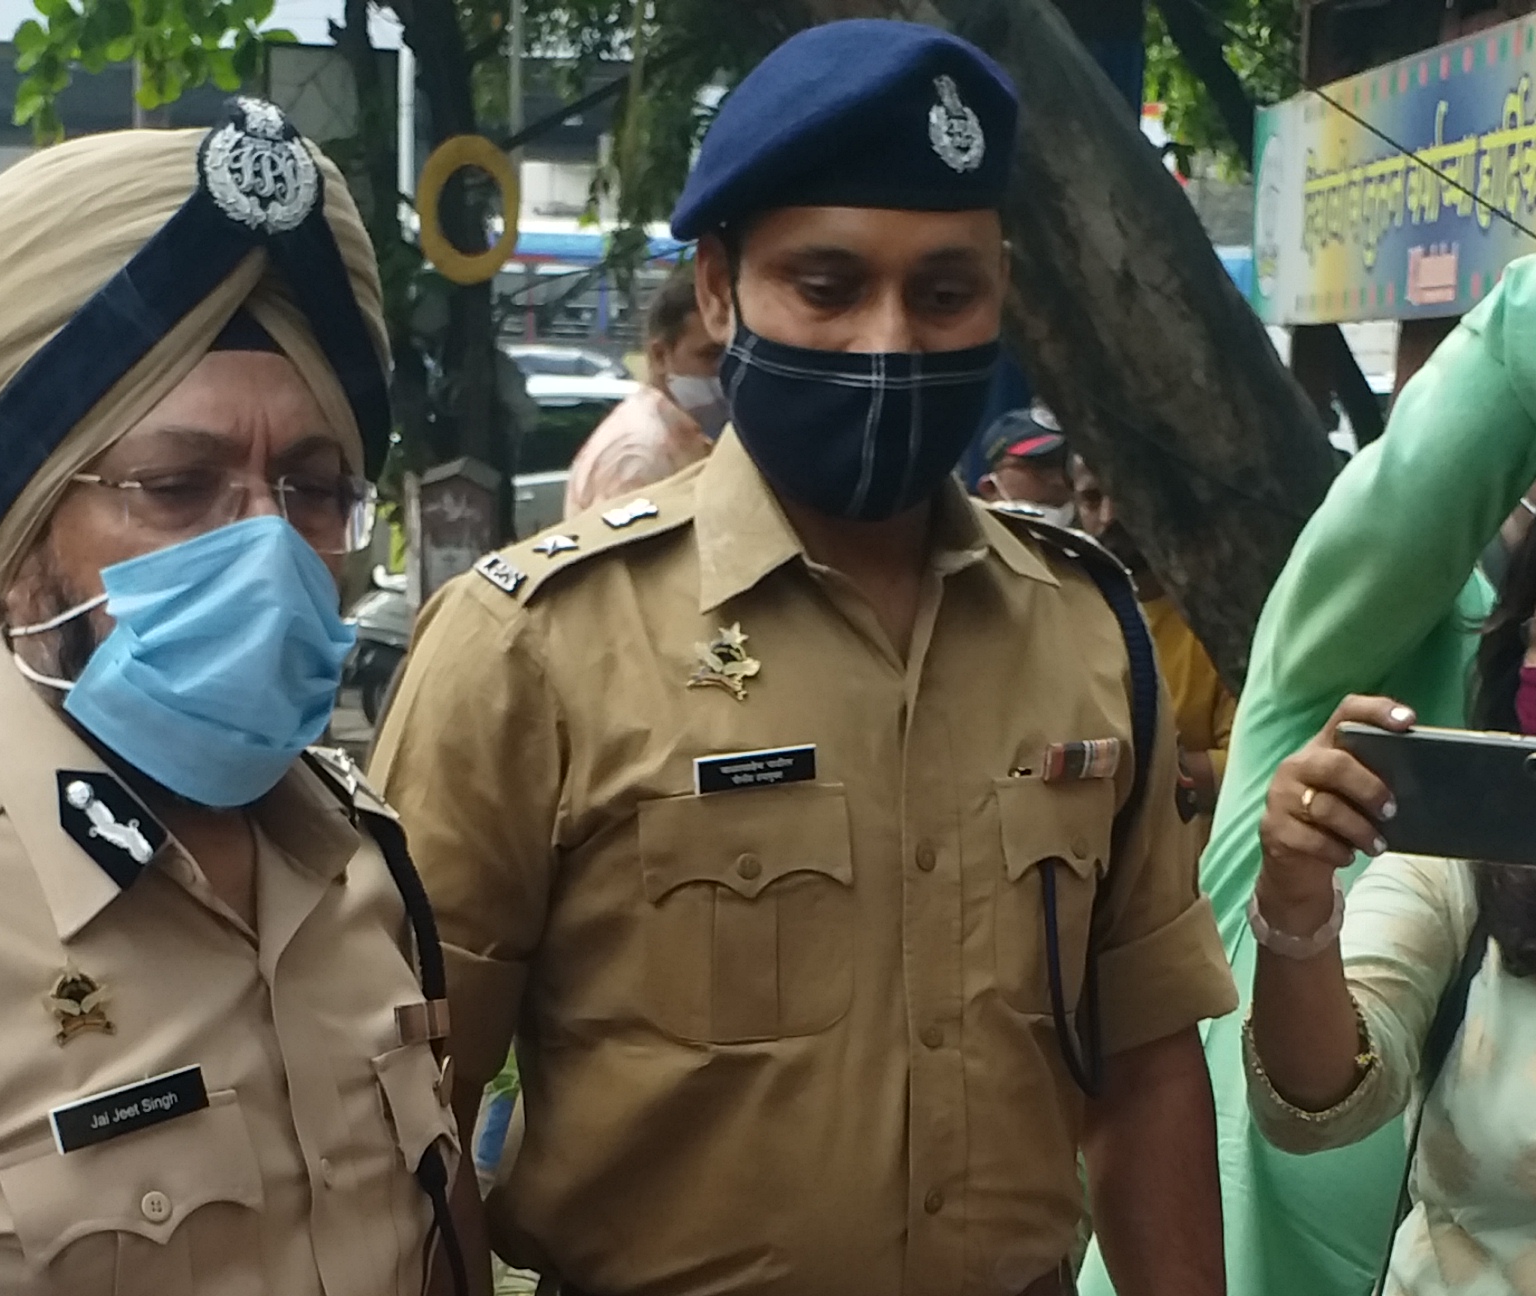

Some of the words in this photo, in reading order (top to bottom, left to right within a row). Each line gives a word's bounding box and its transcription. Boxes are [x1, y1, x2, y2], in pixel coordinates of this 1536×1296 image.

[90, 1111, 109, 1129] Jai
[113, 1105, 140, 1123] Jeet
[142, 1091, 179, 1113] Singh
